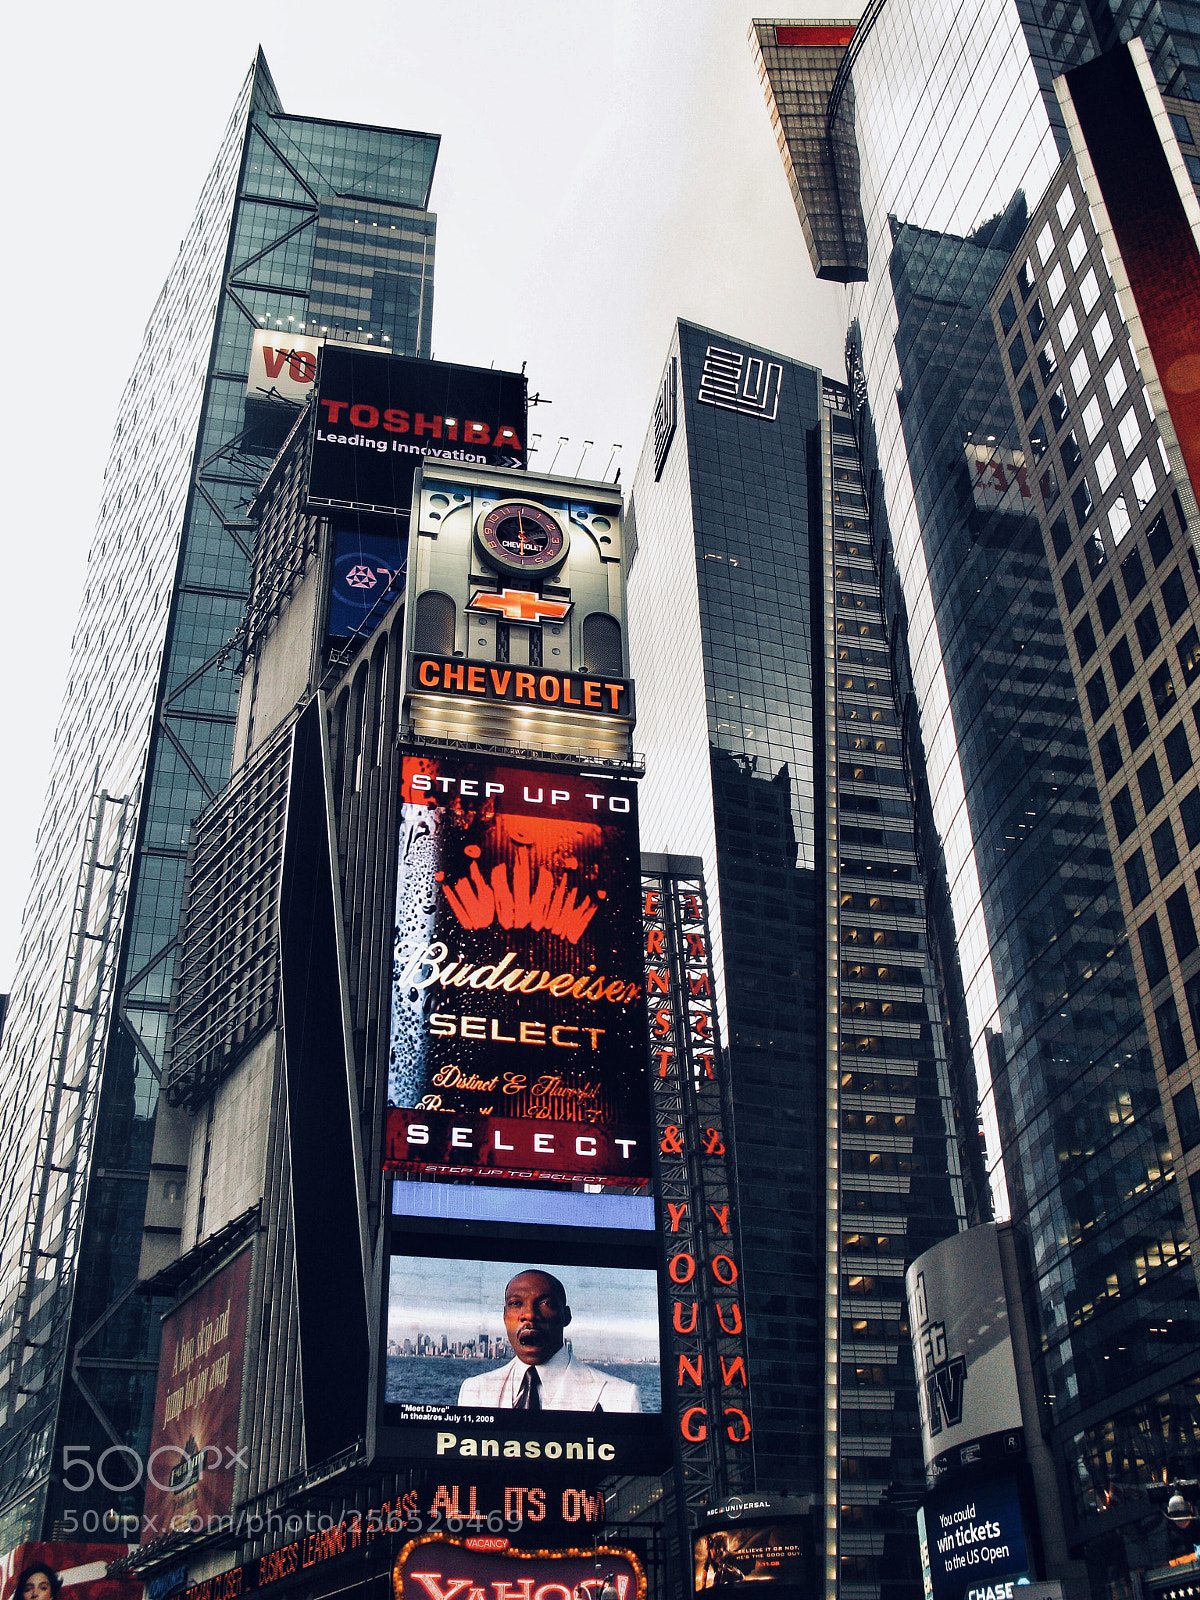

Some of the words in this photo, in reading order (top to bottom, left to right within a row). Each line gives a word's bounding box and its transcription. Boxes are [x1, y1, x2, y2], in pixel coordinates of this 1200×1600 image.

[321, 399, 523, 450] TOSHIBA
[317, 430, 388, 452] Leading
[392, 440, 487, 464] Innovation
[419, 660, 625, 710] CHEVROLET
[411, 774, 505, 798] STEP
[523, 787, 570, 806] UP
[586, 793, 630, 813] TO
[394, 941, 641, 1004] Budweiser
[645, 892, 674, 1077] ERNST
[430, 1013, 605, 1050] SELECT
[432, 1064, 499, 1092] Distinct
[502, 1072, 526, 1094] &
[406, 1124, 637, 1158] SELECT
[660, 1125, 683, 1153] &
[425, 1165, 473, 1174] STEP
[538, 1173, 607, 1183] SELECT
[172, 1341, 179, 1378] A
[196, 1316, 212, 1359] skip
[214, 1298, 231, 1345] and
[667, 1203, 707, 1442] YOUNG
[162, 1386, 184, 1431] jump
[184, 1372, 196, 1410] for
[194, 1364, 209, 1409] joy
[925, 1354, 968, 1438] IV
[444, 1414, 460, 1423] July
[463, 1415, 474, 1423] 11,
[436, 1432, 616, 1461] Panasonic
[431, 1485, 488, 1520] ALL
[504, 1487, 546, 1522] ITS
[726, 1501, 770, 1512] UNIVERSAL
[939, 1514, 953, 1528] You
[953, 1503, 976, 1523] could
[466, 1538, 508, 1548] VACANCY
[937, 1531, 955, 1554] win
[955, 1520, 1001, 1547] tickets
[945, 1560, 953, 1572] to
[953, 1554, 966, 1569] the
[966, 1549, 980, 1564] US
[981, 1545, 1010, 1564] Open
[968, 1582, 1014, 1600] CHASE
